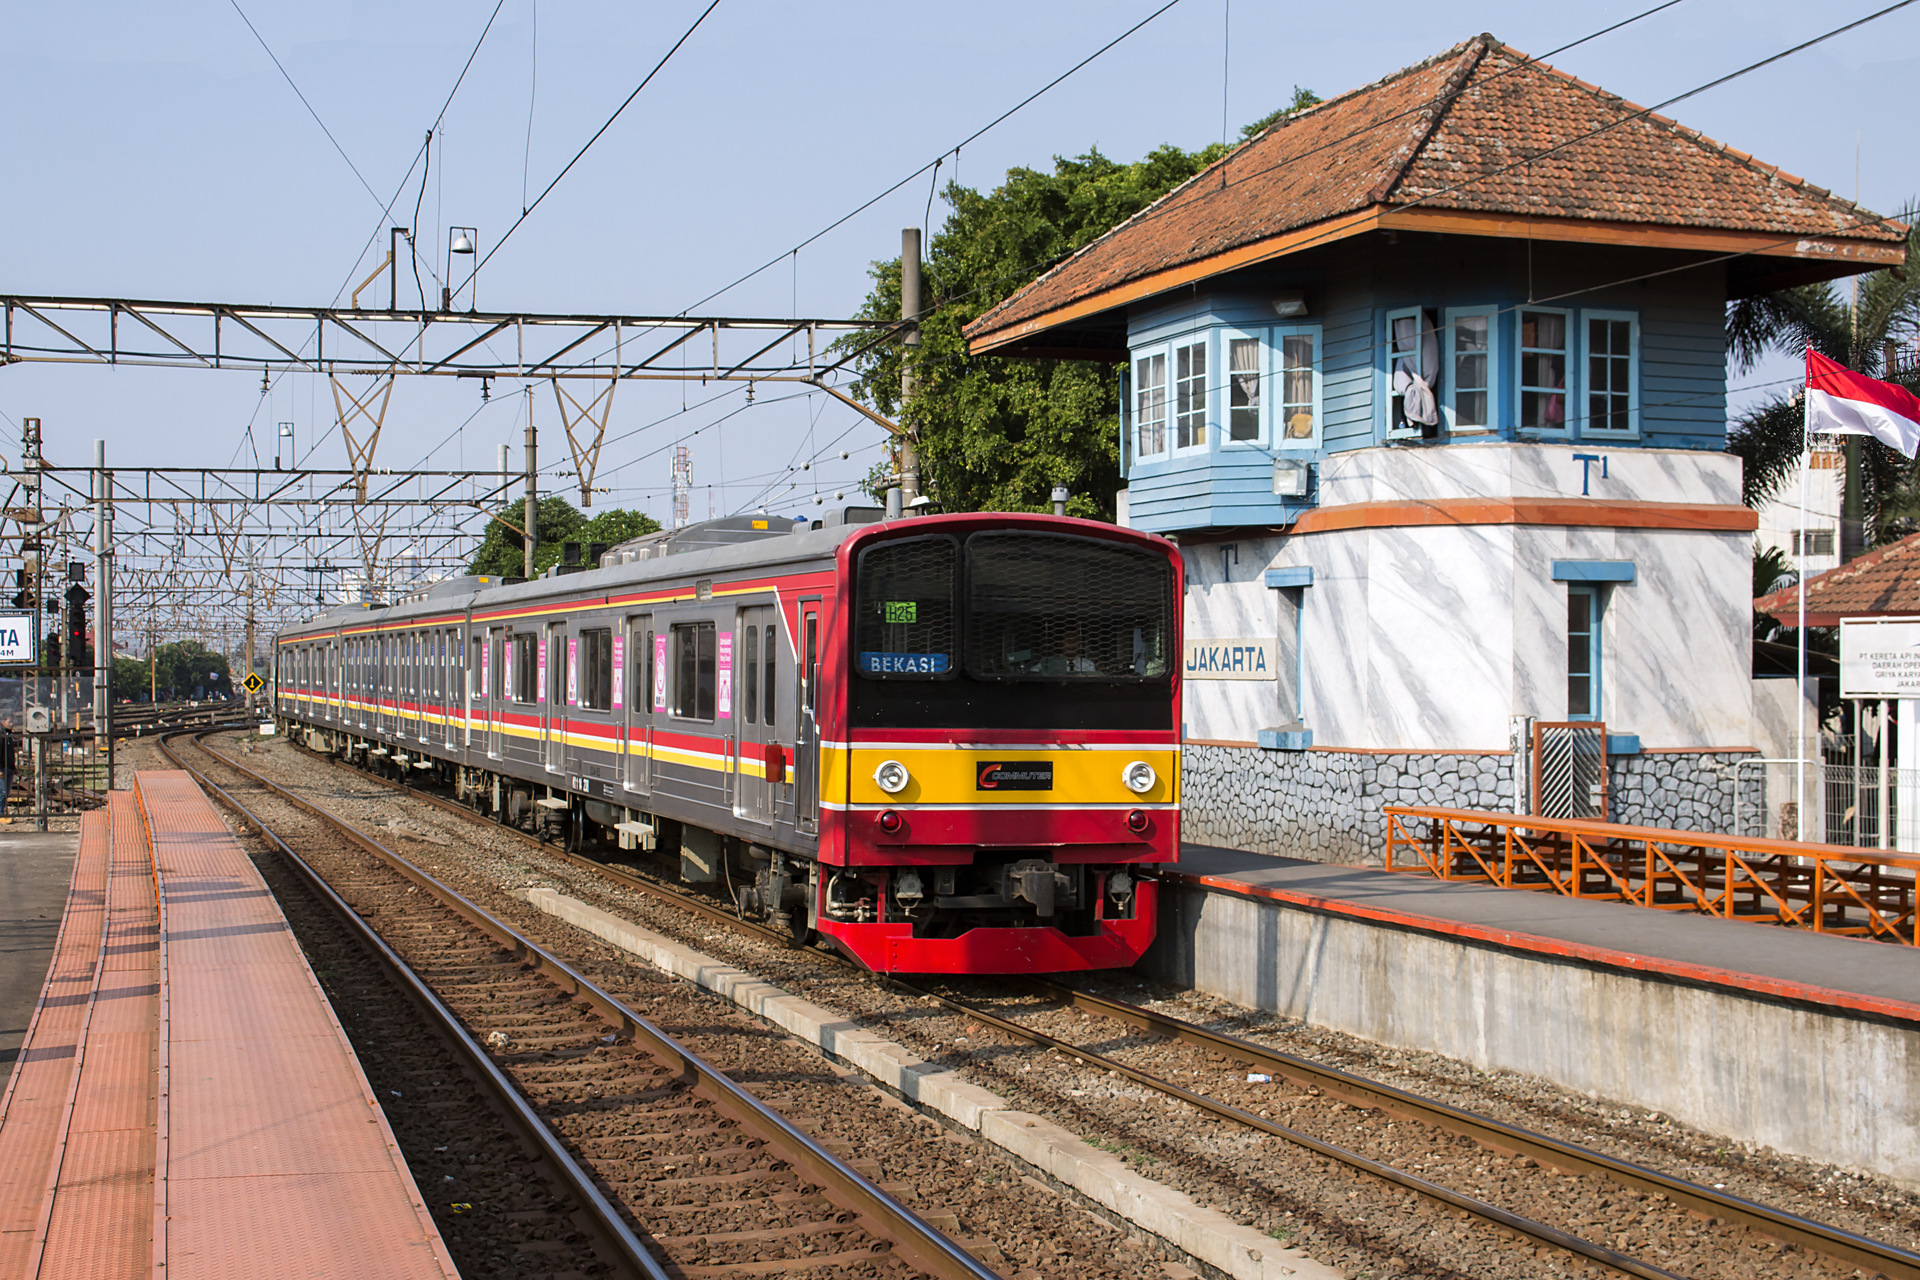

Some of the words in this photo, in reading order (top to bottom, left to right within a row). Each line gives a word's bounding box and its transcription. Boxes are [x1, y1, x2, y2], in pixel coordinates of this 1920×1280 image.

[1572, 453, 1609, 497] T1
[889, 605, 913, 621] H25
[1186, 646, 1267, 672] JAKARTA
[1870, 652, 1897, 660] KERETA
[1899, 652, 1912, 660] API
[871, 657, 935, 673] BEKASI
[1872, 661, 1902, 669] DAERAH
[249, 677, 255, 688] 1
[992, 771, 1052, 781] COMMUTER
